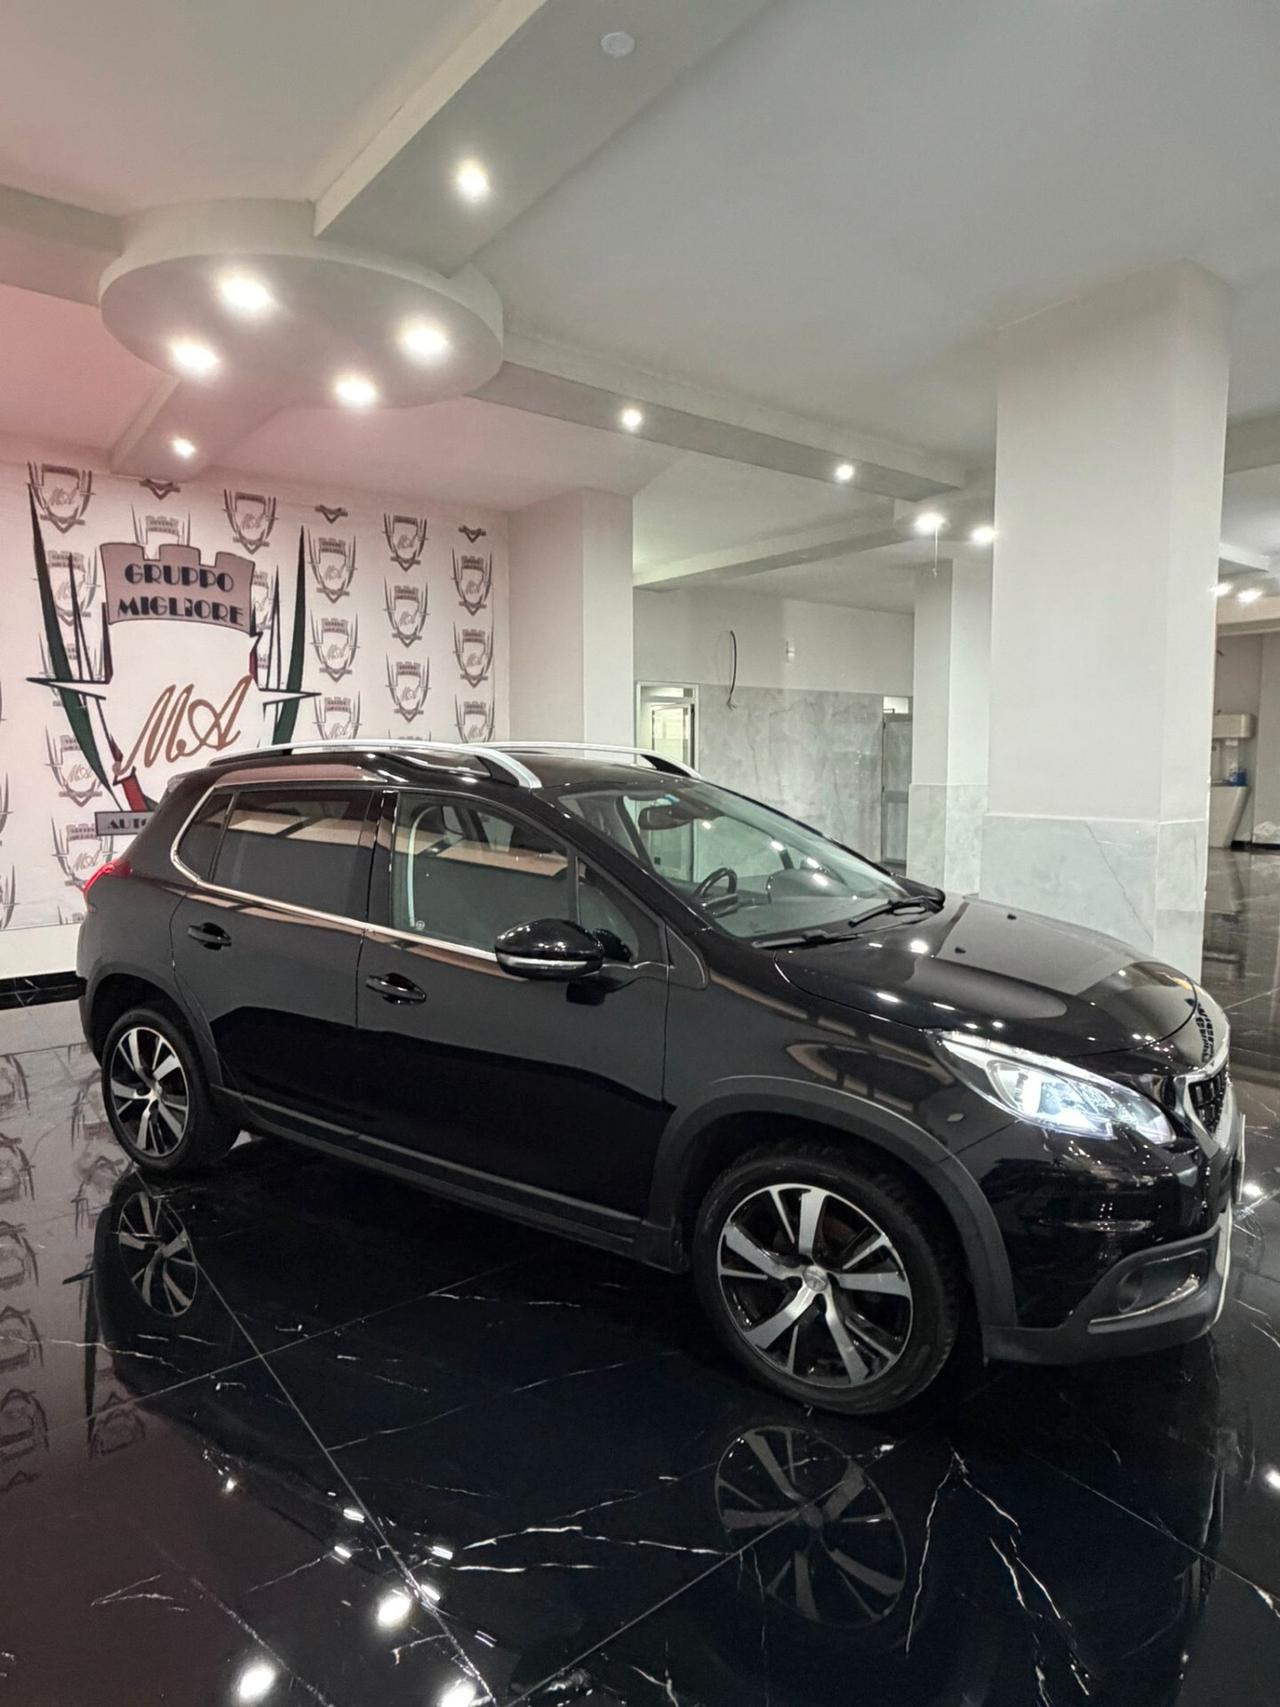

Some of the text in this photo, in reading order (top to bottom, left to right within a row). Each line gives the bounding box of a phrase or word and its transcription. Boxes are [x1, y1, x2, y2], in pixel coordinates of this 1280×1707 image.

[124, 563, 234, 593] GRUPPO
[117, 595, 244, 627] MIGLIORE
[112, 673, 252, 775] MA
